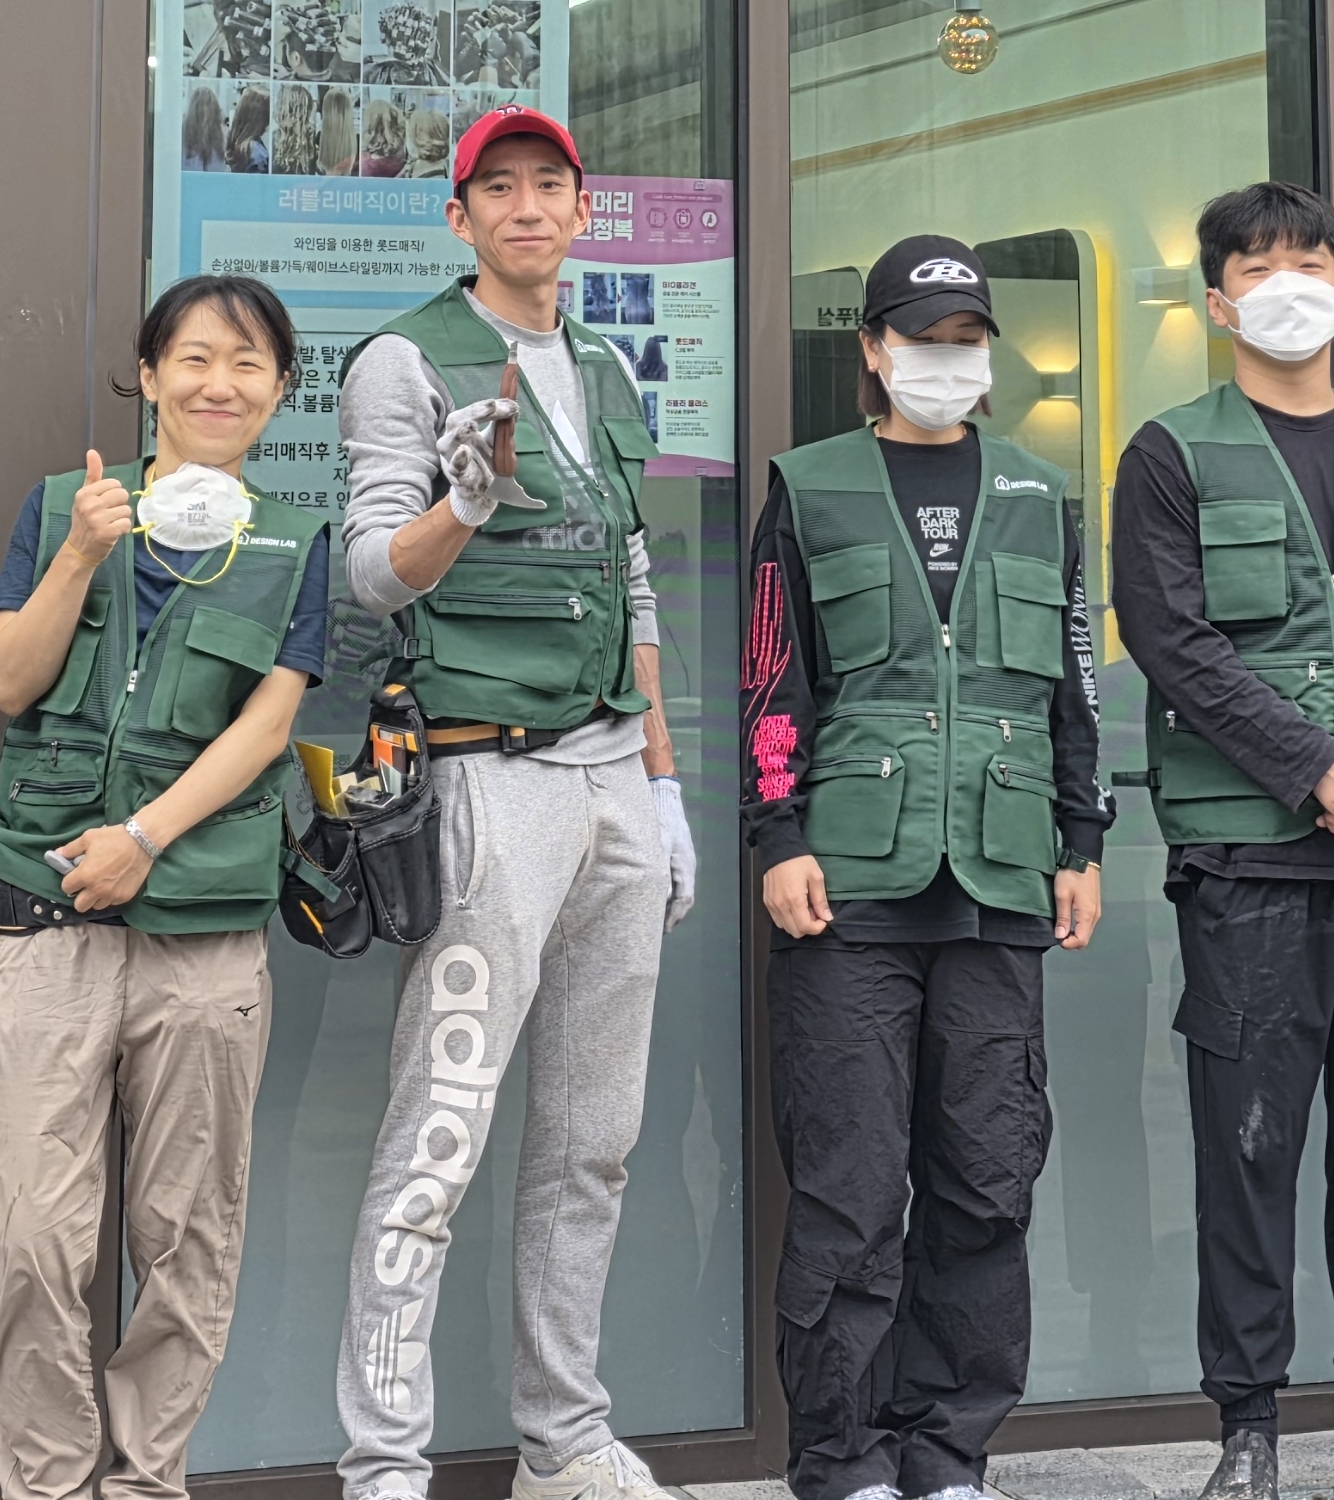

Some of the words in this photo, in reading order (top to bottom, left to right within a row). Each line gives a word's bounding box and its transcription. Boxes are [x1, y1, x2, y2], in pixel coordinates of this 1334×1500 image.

[278, 188, 441, 215] 러블리매직이란?
[592, 190, 634, 215] 머리
[575, 217, 635, 242] 정복
[293, 236, 337, 251] 와인딩을
[341, 238, 373, 252] 이용한
[407, 262, 441, 276] 가능한
[246, 441, 331, 462] 블리매직후
[916, 506, 960, 519] AFTER
[920, 517, 958, 530] DARK
[921, 528, 959, 540] TOUR
[250, 536, 279, 548] DESIGN
[279, 539, 297, 549] LAB
[1070, 563, 1092, 652] WOM
[1078, 653, 1098, 706] NIKE
[374, 944, 500, 1287] adidas
